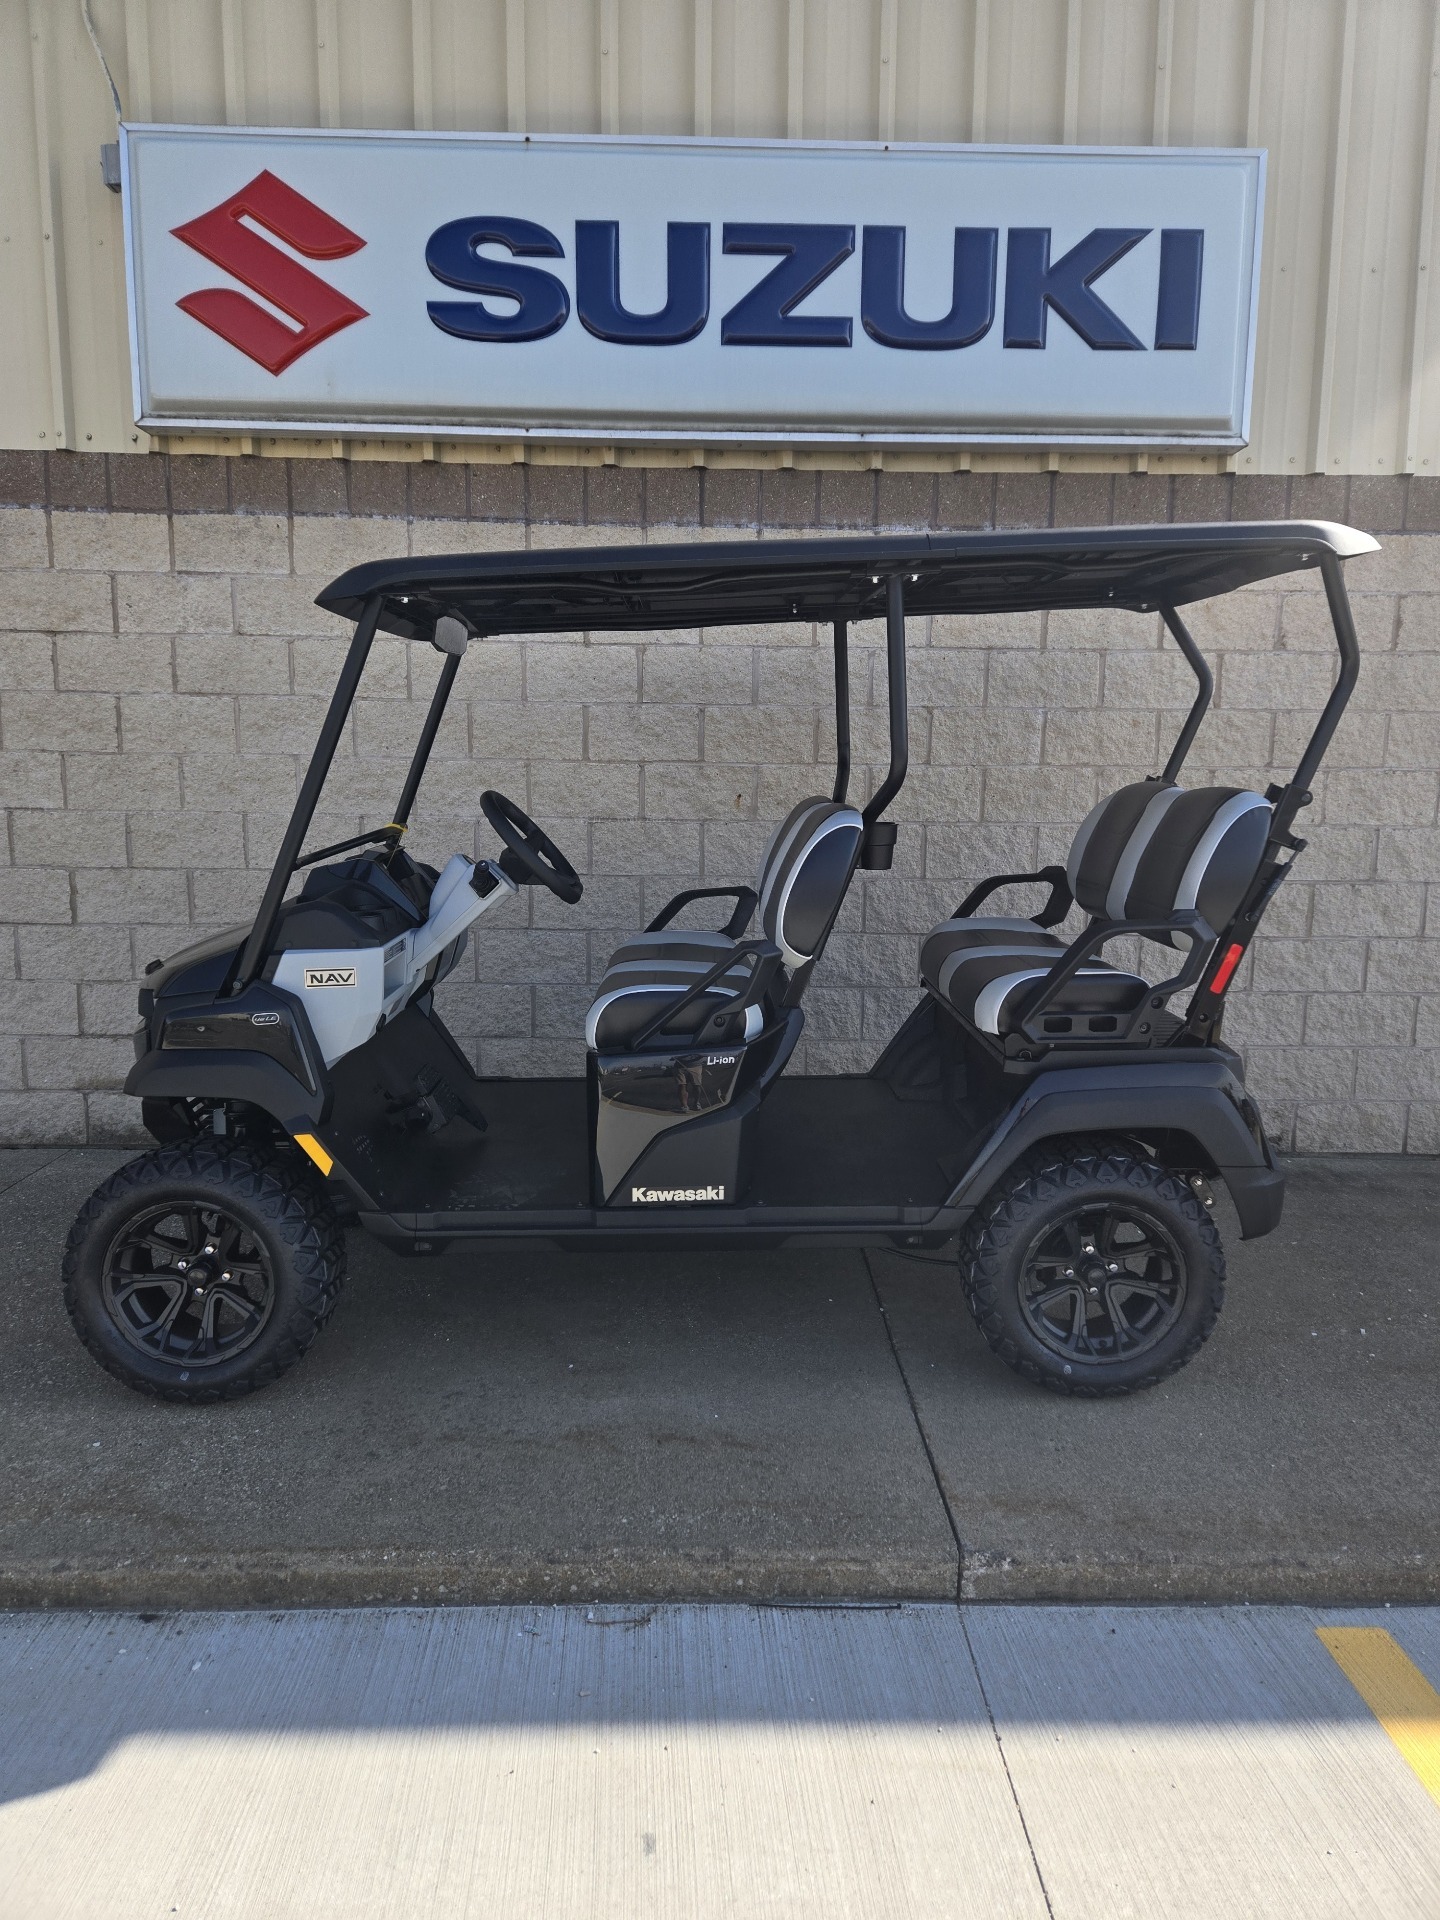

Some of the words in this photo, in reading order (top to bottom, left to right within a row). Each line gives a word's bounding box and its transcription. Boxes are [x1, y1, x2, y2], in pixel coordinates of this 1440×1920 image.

[425, 214, 1204, 352] SUZUKI
[310, 973, 353, 984] NAV
[707, 1056, 735, 1065] Li-ion
[631, 1185, 725, 1202] Kawasaki
